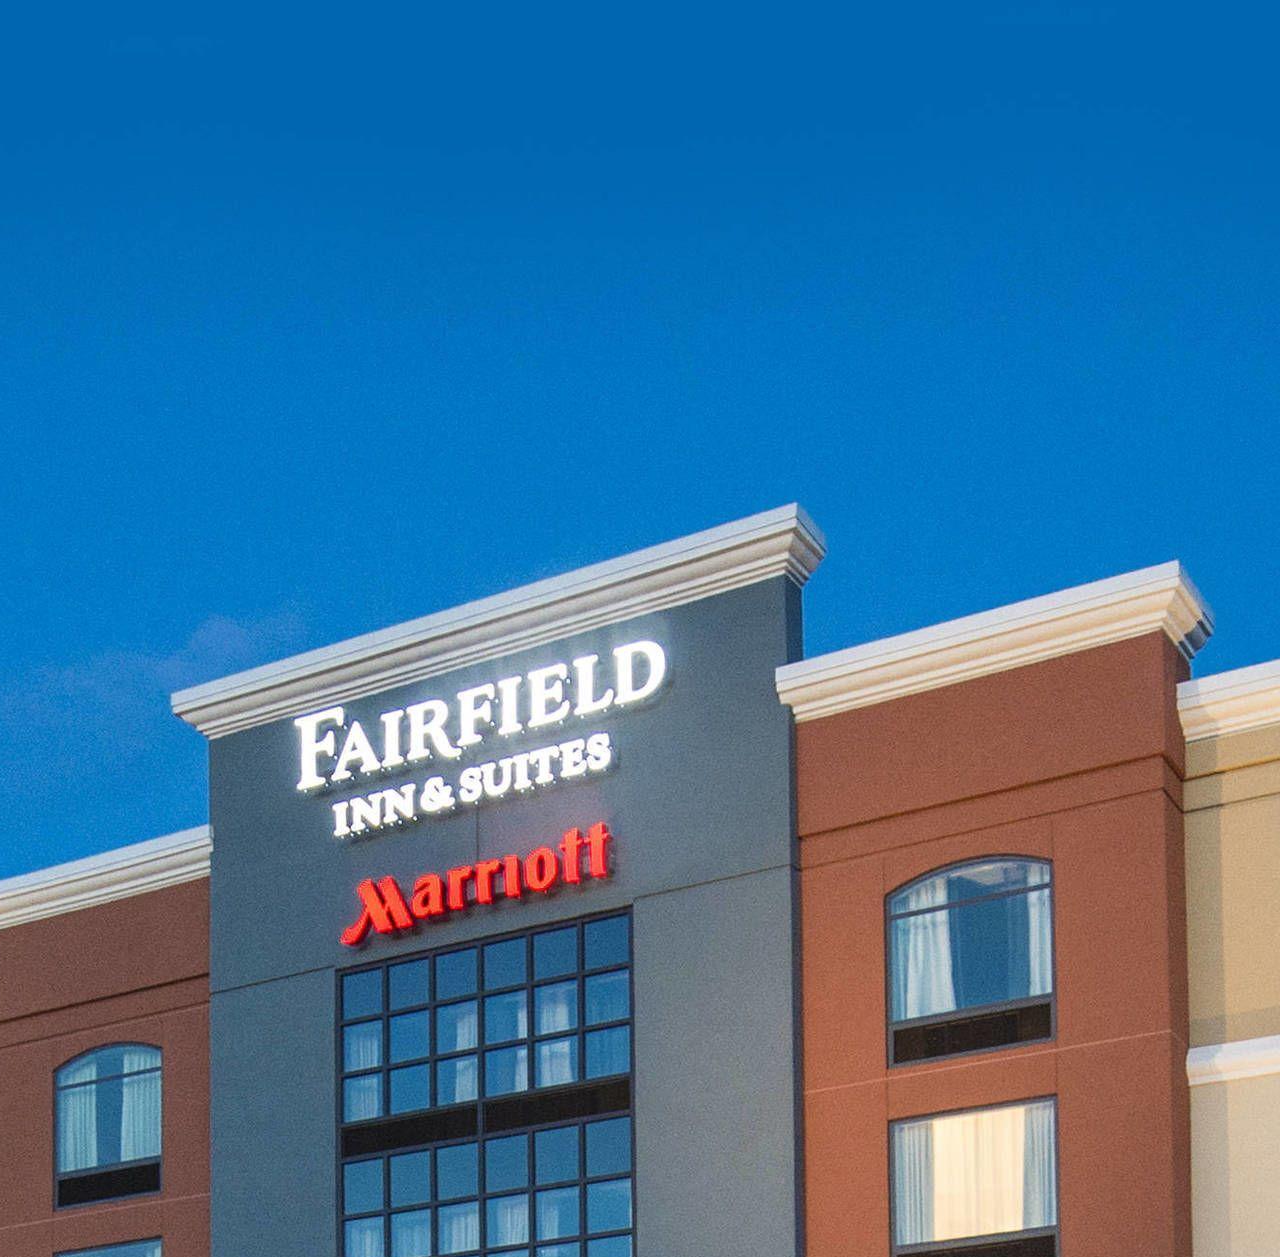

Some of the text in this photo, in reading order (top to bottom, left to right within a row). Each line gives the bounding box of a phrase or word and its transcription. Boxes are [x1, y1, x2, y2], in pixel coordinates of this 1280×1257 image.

[293, 640, 667, 791] FAIRFIELD
[331, 732, 612, 837] INN & SUITES
[339, 820, 613, 946] Marriott
